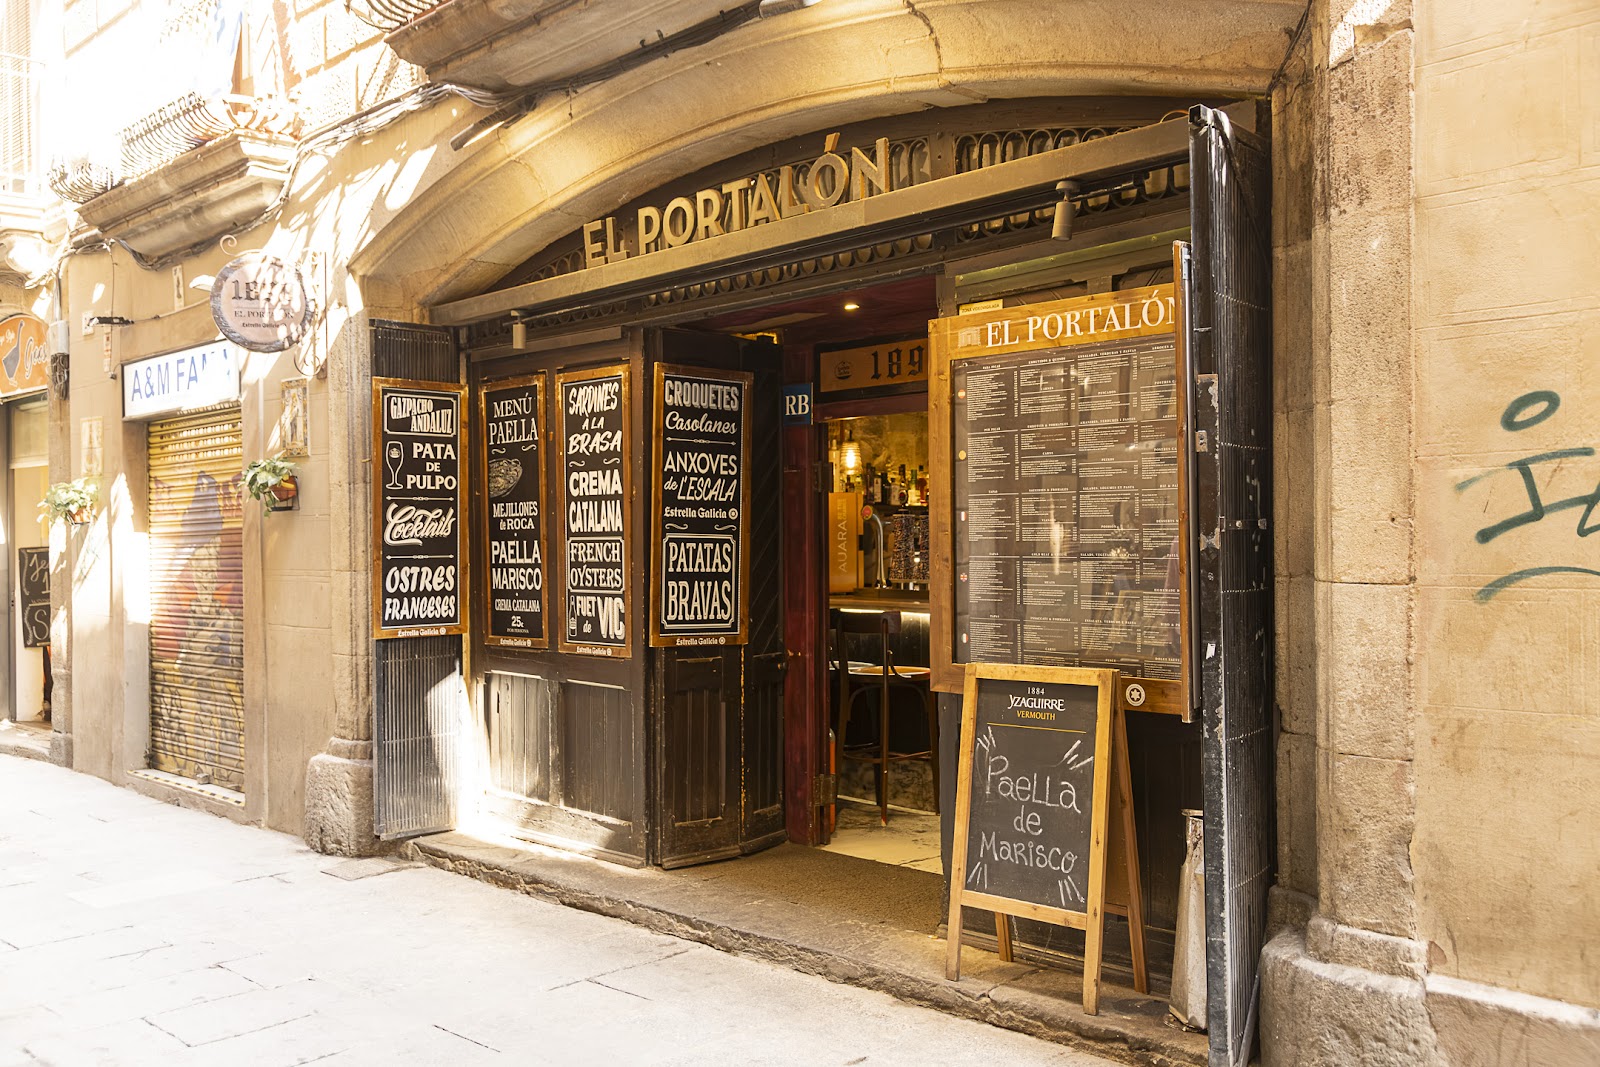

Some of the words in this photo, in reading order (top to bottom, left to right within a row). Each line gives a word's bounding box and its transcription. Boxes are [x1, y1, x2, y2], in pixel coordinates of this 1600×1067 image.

[583, 216, 627, 270] EL
[637, 132, 891, 256] PORTALÓN
[985, 321, 1019, 348] EL
[132, 362, 169, 402] A&M
[390, 396, 434, 420] GAZPACHO
[493, 392, 533, 418] MENÚ
[569, 381, 619, 418] SARDINES
[665, 380, 739, 411] CROQUETES
[785, 394, 810, 416] RB
[410, 408, 453, 434] ANDALUZ
[489, 418, 539, 445] PAELLA
[665, 410, 737, 435] Casolanes
[413, 442, 457, 461] PATA
[567, 430, 622, 456] BRASA
[426, 461, 441, 472] DE
[664, 451, 737, 476] ANXOVES
[406, 474, 458, 491] PULPO
[569, 469, 623, 497] CREMA
[664, 476, 678, 492] de
[677, 475, 738, 502] L'ESCALA
[492, 500, 538, 518] MEJILLONES
[569, 499, 623, 533] CATALANA
[663, 506, 697, 518] Estrella
[697, 506, 727, 519] Galicia
[384, 501, 456, 547] Cocktails
[500, 519, 507, 530] de
[507, 518, 535, 530] ROCA
[491, 540, 542, 564] PAELLA
[570, 541, 621, 564] FRENCH
[668, 541, 731, 573] PATATAS
[837, 520, 848, 573] AUARA
[386, 565, 455, 593] OSTRES
[491, 567, 542, 591] MARISCO
[570, 564, 621, 590] OYSTERS
[384, 594, 455, 621] FRANCESES
[494, 598, 512, 611] CREMA
[512, 599, 540, 612] CATALANA
[576, 595, 596, 617] FUET
[666, 579, 731, 621] BRAVAS
[583, 620, 592, 633] de
[597, 596, 626, 640] VIC
[398, 628, 420, 637] Estrella
[420, 627, 439, 636] Galicia
[676, 638, 698, 646] Estrella
[698, 637, 718, 646] Galicia
[1007, 694, 1065, 711] YZAGUIRRE
[1027, 686, 1045, 695] 1884
[1017, 710, 1056, 721] VERMOUTH
[1013, 804, 1043, 836] de
